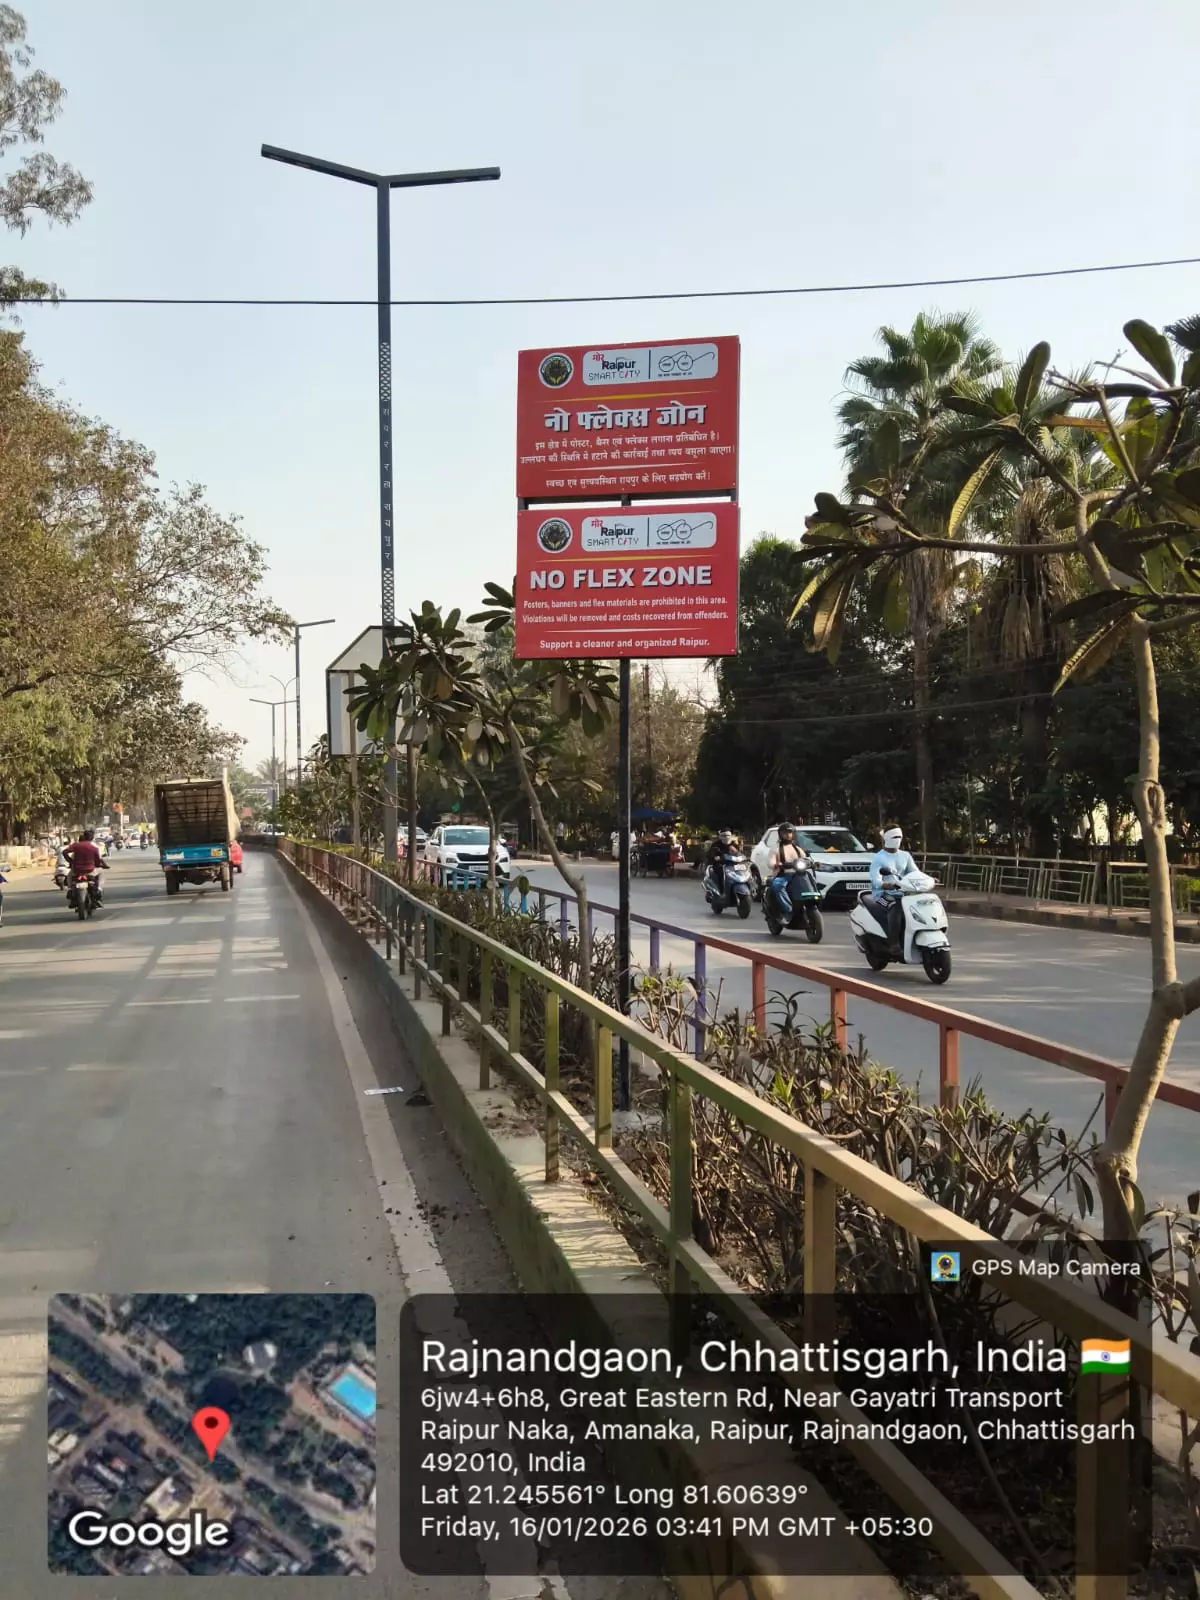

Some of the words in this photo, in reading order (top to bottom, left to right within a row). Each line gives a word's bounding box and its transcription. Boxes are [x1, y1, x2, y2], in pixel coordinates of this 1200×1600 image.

[602, 357, 635, 371] Raipur
[589, 372, 616, 381] SMART
[619, 370, 640, 379] CITY
[544, 408, 570, 432] नो
[576, 405, 650, 430] फ्लेक्स
[657, 401, 707, 426] जोन
[600, 523, 635, 538] Raipur
[587, 538, 615, 547] SMART
[618, 537, 639, 545] CITY
[530, 569, 565, 589] NO
[573, 567, 636, 588] FLEX
[642, 565, 712, 587] ZONE
[523, 600, 550, 610] Posters,
[552, 599, 577, 608] banners
[580, 599, 591, 608] and
[592, 599, 606, 607] flex
[607, 598, 638, 607] materials
[639, 598, 650, 606] are
[652, 596, 686, 607] prohibited
[687, 597, 694, 605] in
[695, 596, 709, 605] this
[710, 596, 728, 604] area.
[523, 615, 555, 623] Violations
[556, 614, 568, 623] will
[569, 614, 578, 622] be
[579, 613, 607, 622] removed
[609, 613, 621, 621] and
[623, 613, 641, 621] costs
[642, 612, 676, 621] recovered
[677, 611, 693, 620] from
[695, 611, 728, 619] offenders.
[540, 640, 573, 651] Support
[583, 639, 615, 648] cleaner
[617, 639, 632, 647] and
[635, 638, 677, 649] organized
[679, 637, 709, 648] Raipur.
